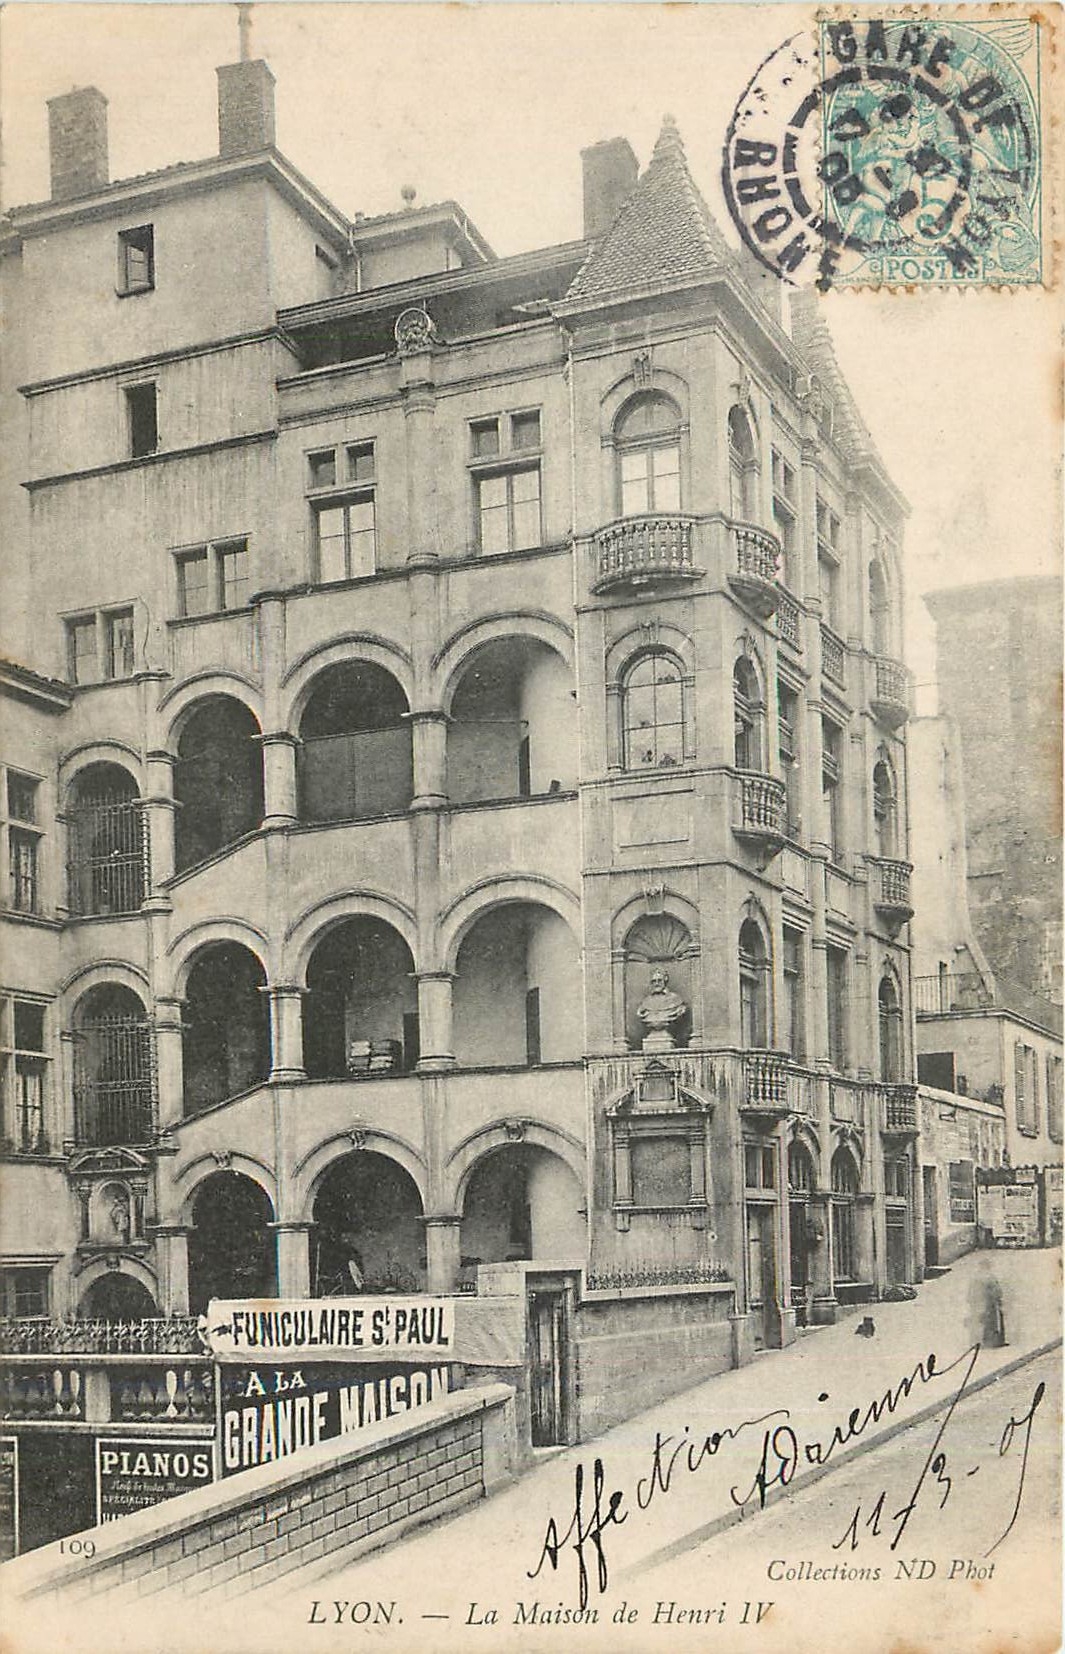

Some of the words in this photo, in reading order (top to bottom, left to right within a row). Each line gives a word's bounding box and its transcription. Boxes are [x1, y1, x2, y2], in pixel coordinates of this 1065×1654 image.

[827, 20, 957, 77] GARE
[886, 257, 979, 281] POSTES
[232, 1310, 364, 1347] FUNICULAIRE
[395, 1307, 449, 1346] PAUL
[245, 1371, 266, 1398] A
[274, 1370, 307, 1394] LA
[224, 1392, 329, 1469] GRANDE
[339, 1366, 449, 1436] MAISON
[101, 1451, 209, 1478] PIANOS
[527, 1409, 790, 1611] Affection
